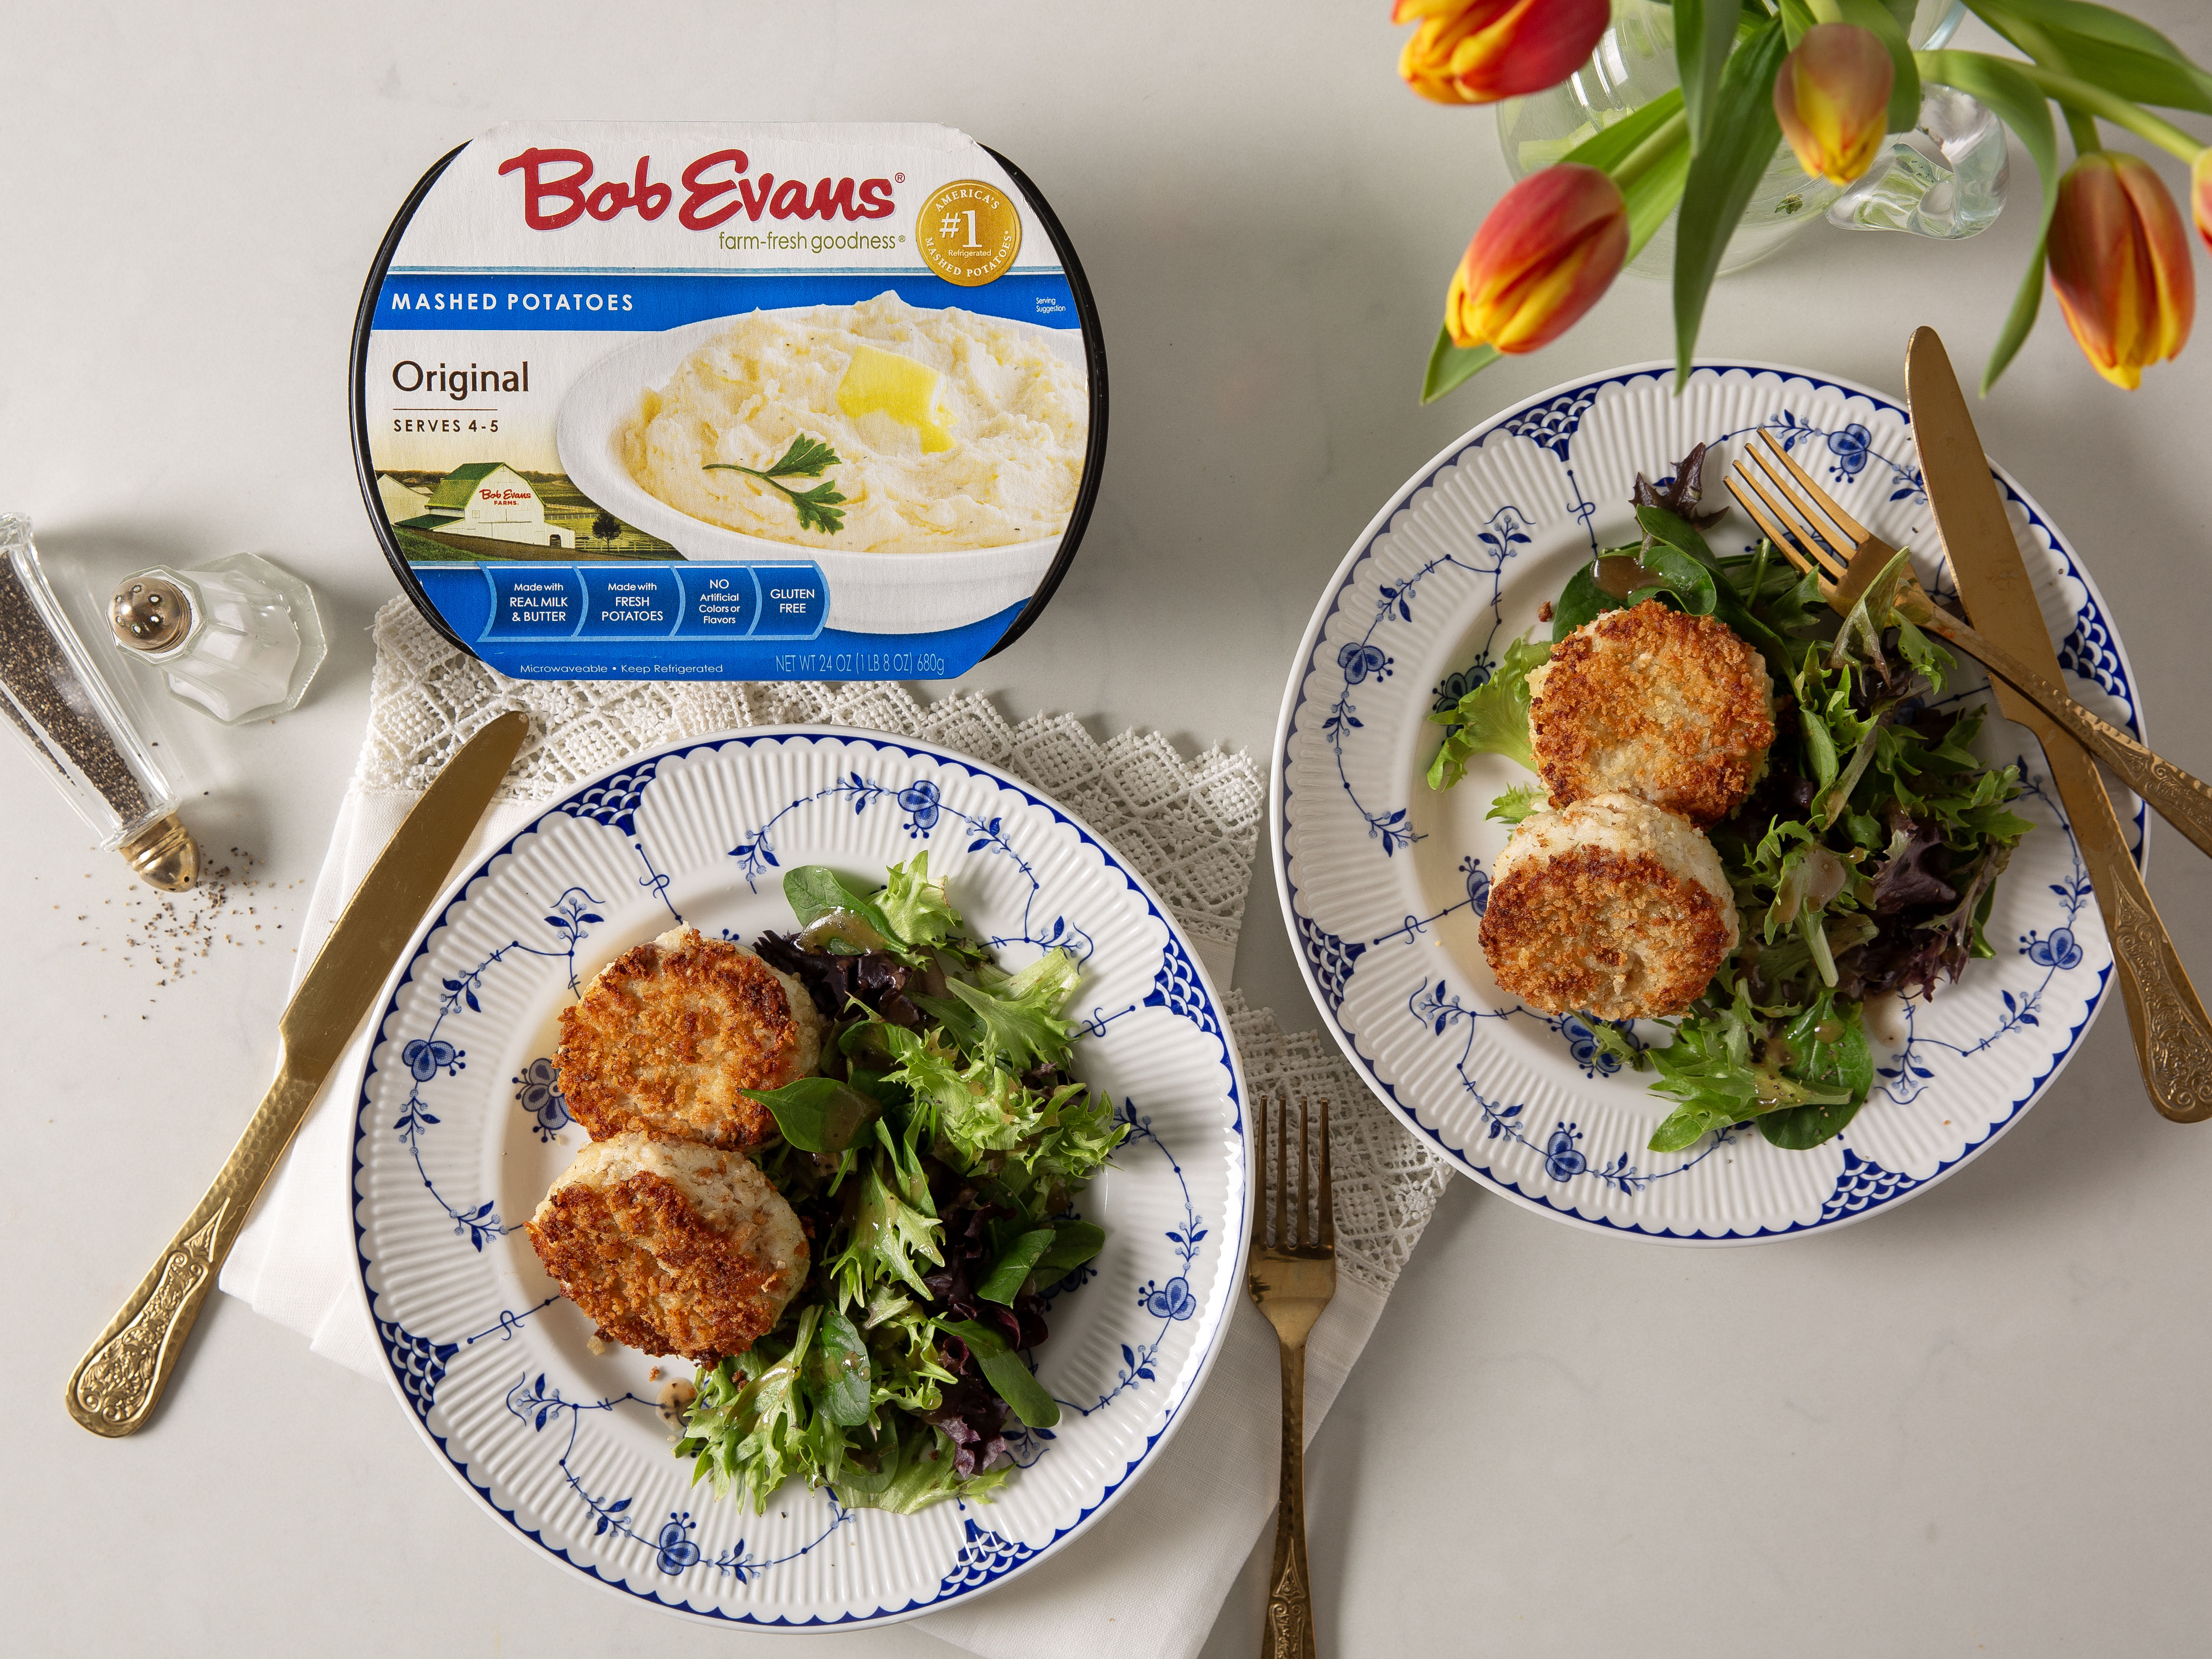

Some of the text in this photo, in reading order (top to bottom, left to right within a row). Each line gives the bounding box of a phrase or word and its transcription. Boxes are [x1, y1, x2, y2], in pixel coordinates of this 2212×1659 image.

[498, 147, 672, 231] Bob
[940, 210, 983, 248] #1
[720, 232, 810, 250] farm-fresh
[925, 237, 961, 275] MASHED
[948, 249, 992, 258] Refrigerated
[391, 293, 633, 311] MASHED POTATOES
[1036, 297, 1056, 305] Serving
[1036, 305, 1066, 314] Suggestion
[392, 360, 529, 401] Original
[393, 419, 461, 432] SERVES
[479, 489, 531, 500] Bob Evans
[710, 579, 729, 589] NO
[770, 589, 815, 599] GLUTEN
[510, 597, 568, 607] REAL MILK
[615, 597, 650, 607] FRESH
[780, 603, 806, 613] FREE
[512, 612, 566, 621] & BUTTER
[602, 611, 664, 621] POTATOES
[520, 664, 723, 674] Microwaveable Keep Refrigerated
[776, 652, 945, 676] NET WT 24 OZ (1 LB 8 OZ) 680g
